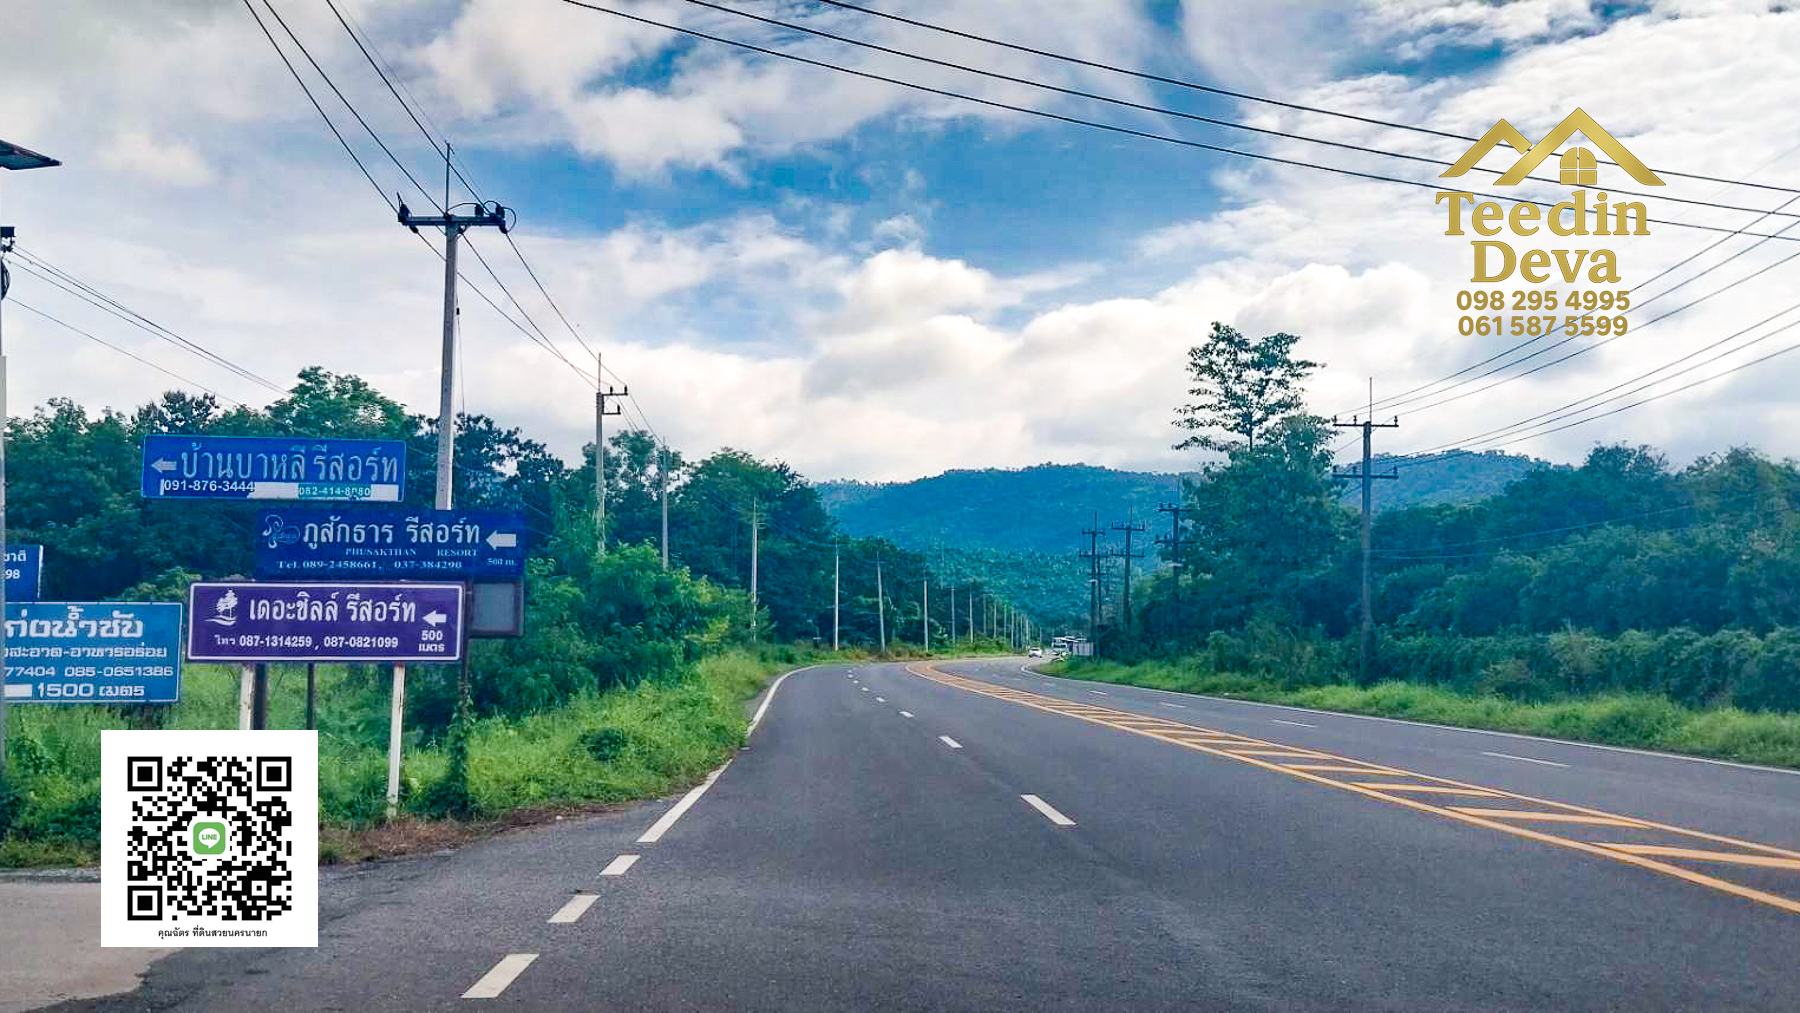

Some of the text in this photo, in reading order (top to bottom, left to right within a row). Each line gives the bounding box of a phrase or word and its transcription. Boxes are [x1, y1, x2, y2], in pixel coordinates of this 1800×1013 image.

[181, 442, 398, 482] บ้านบาหลี รีสอร์ท
[164, 480, 255, 491] 091-876-3444
[303, 515, 394, 549] ภูสักธาร
[405, 516, 480, 543] รีสอร์ท
[437, 549, 478, 557] RESORT
[249, 591, 416, 622] เดอะชิลล์ รีสอร์ท
[324, 636, 399, 649] 087-0821099
[421, 630, 443, 641] 500
[38, 682, 145, 697] 1500 เมตร
